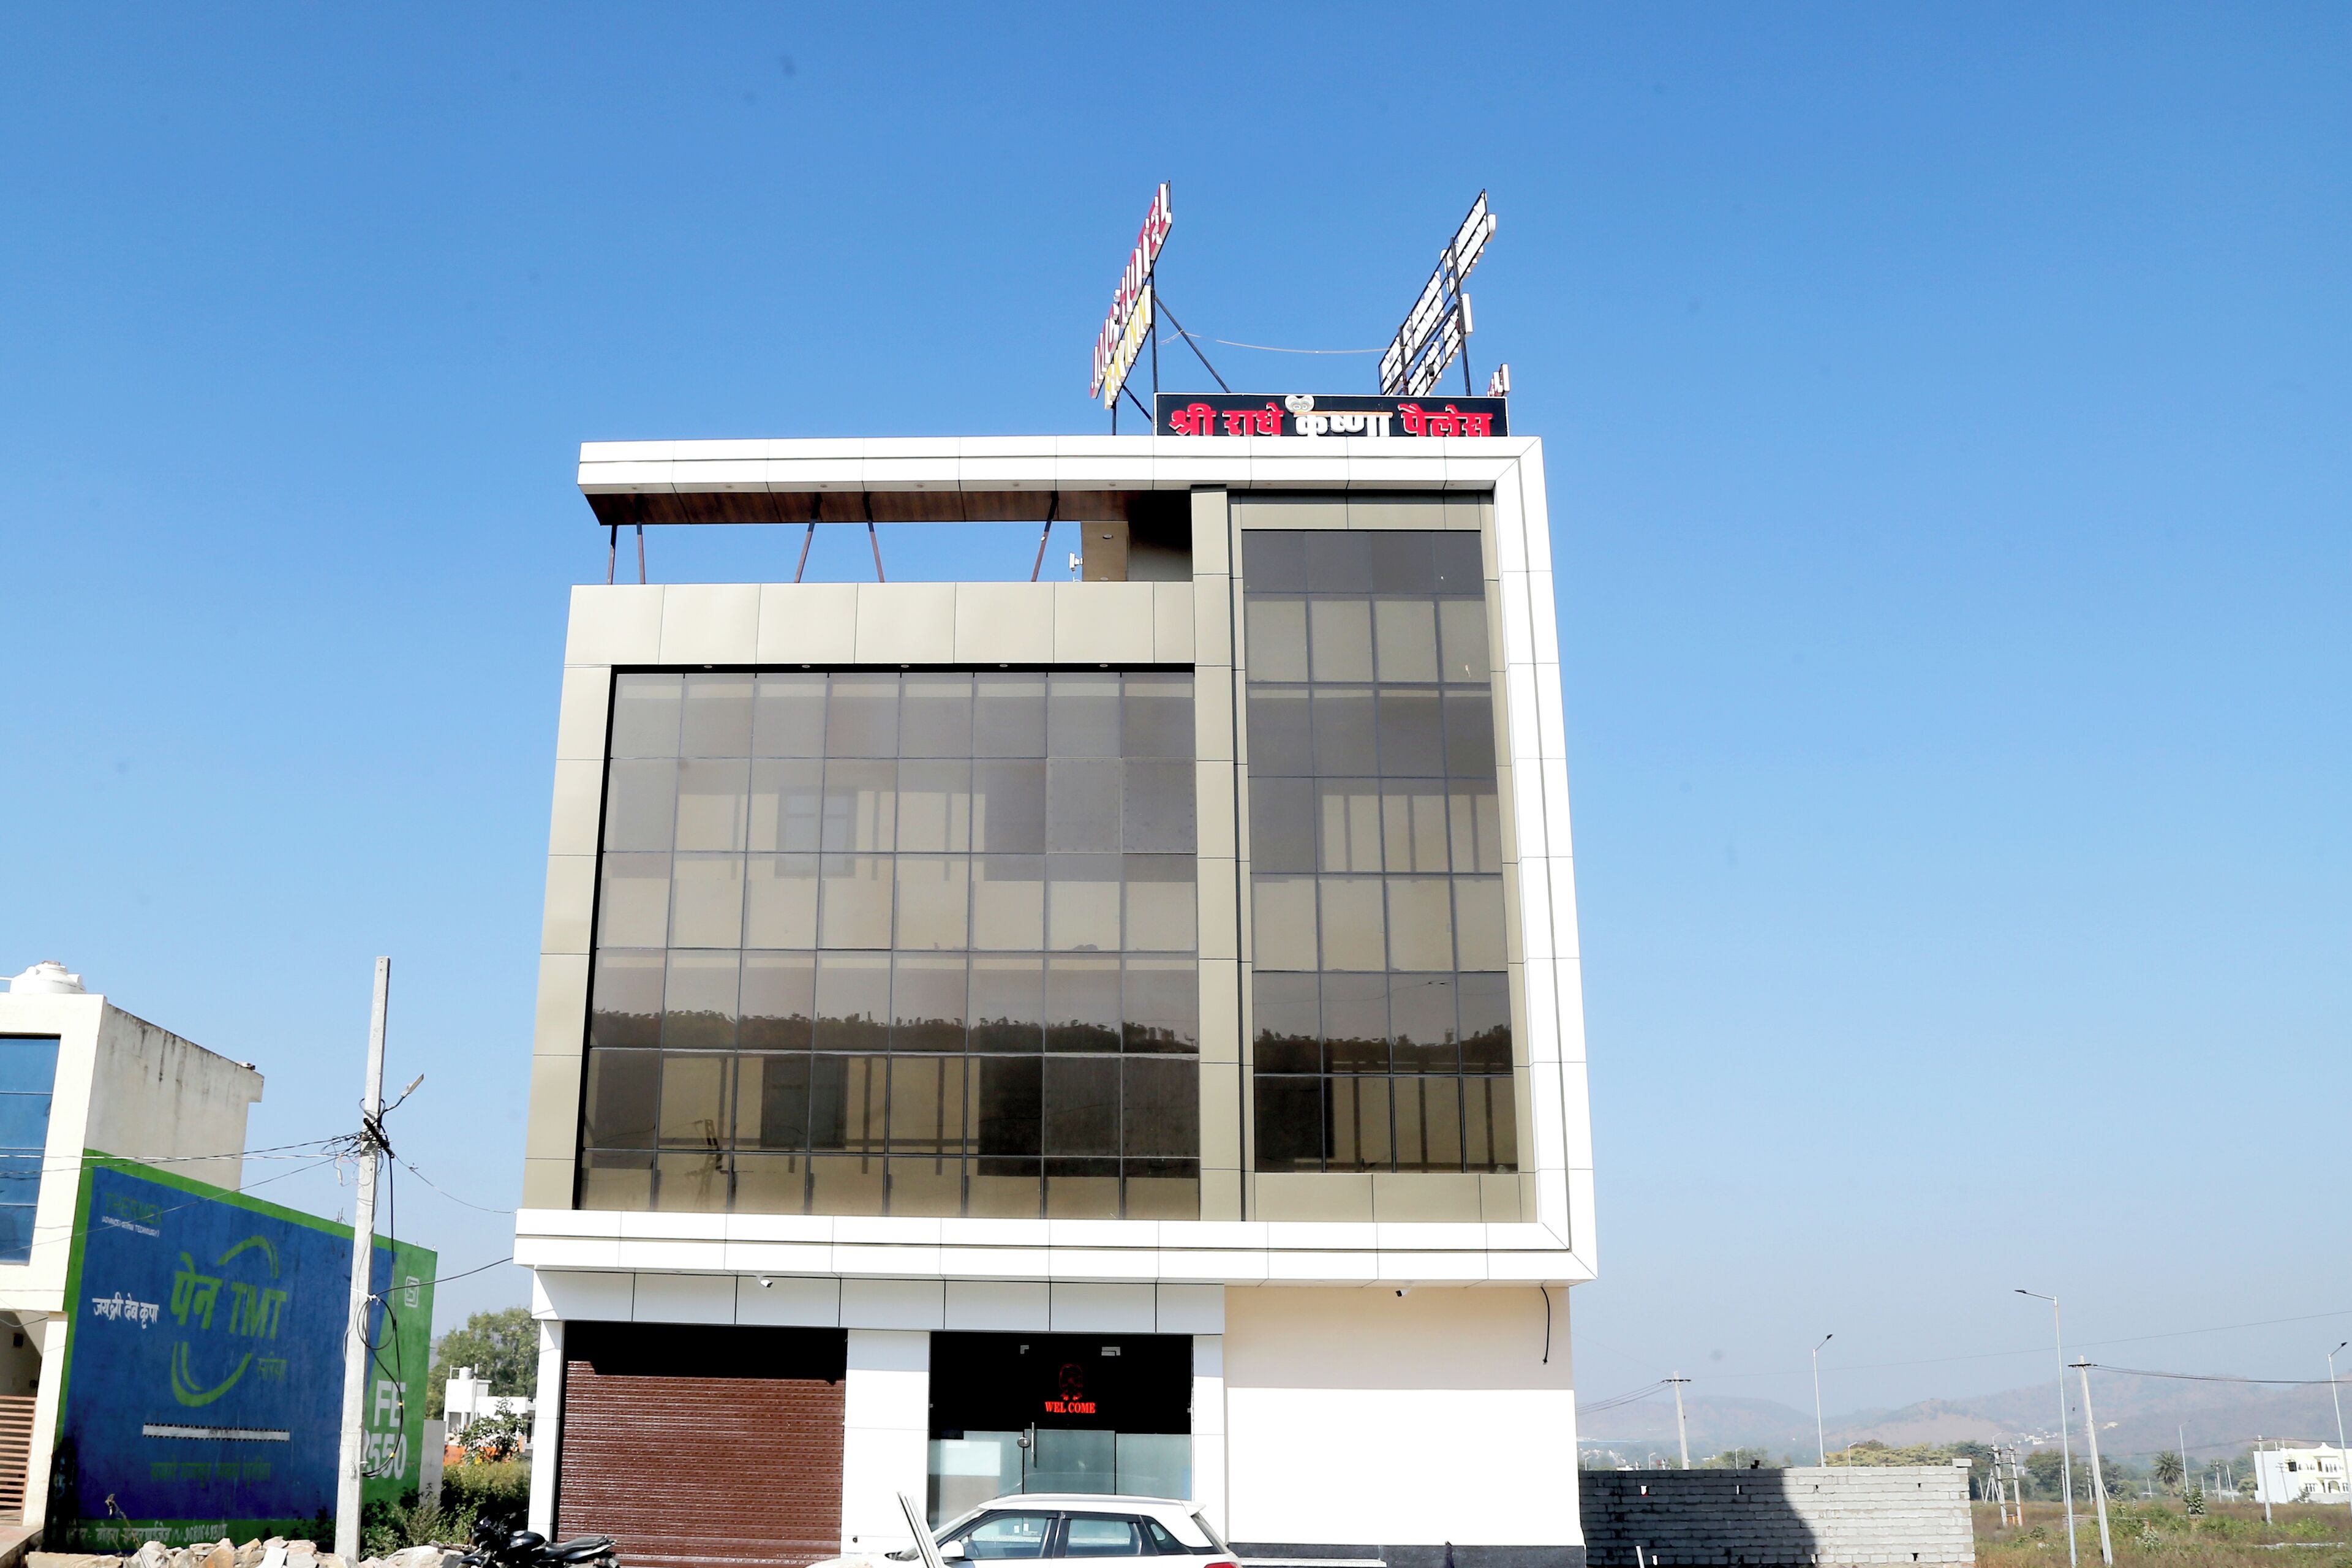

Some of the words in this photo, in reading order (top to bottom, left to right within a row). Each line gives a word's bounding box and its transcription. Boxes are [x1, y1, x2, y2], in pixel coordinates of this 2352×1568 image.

[1169, 402, 1217, 436] श्री
[1294, 411, 1393, 437] कष्णा
[1397, 403, 1493, 437] पैलेस
[139, 1302, 159, 1330] कृपा
[228, 1281, 288, 1340] TMT
[374, 1379, 407, 1428] FE
